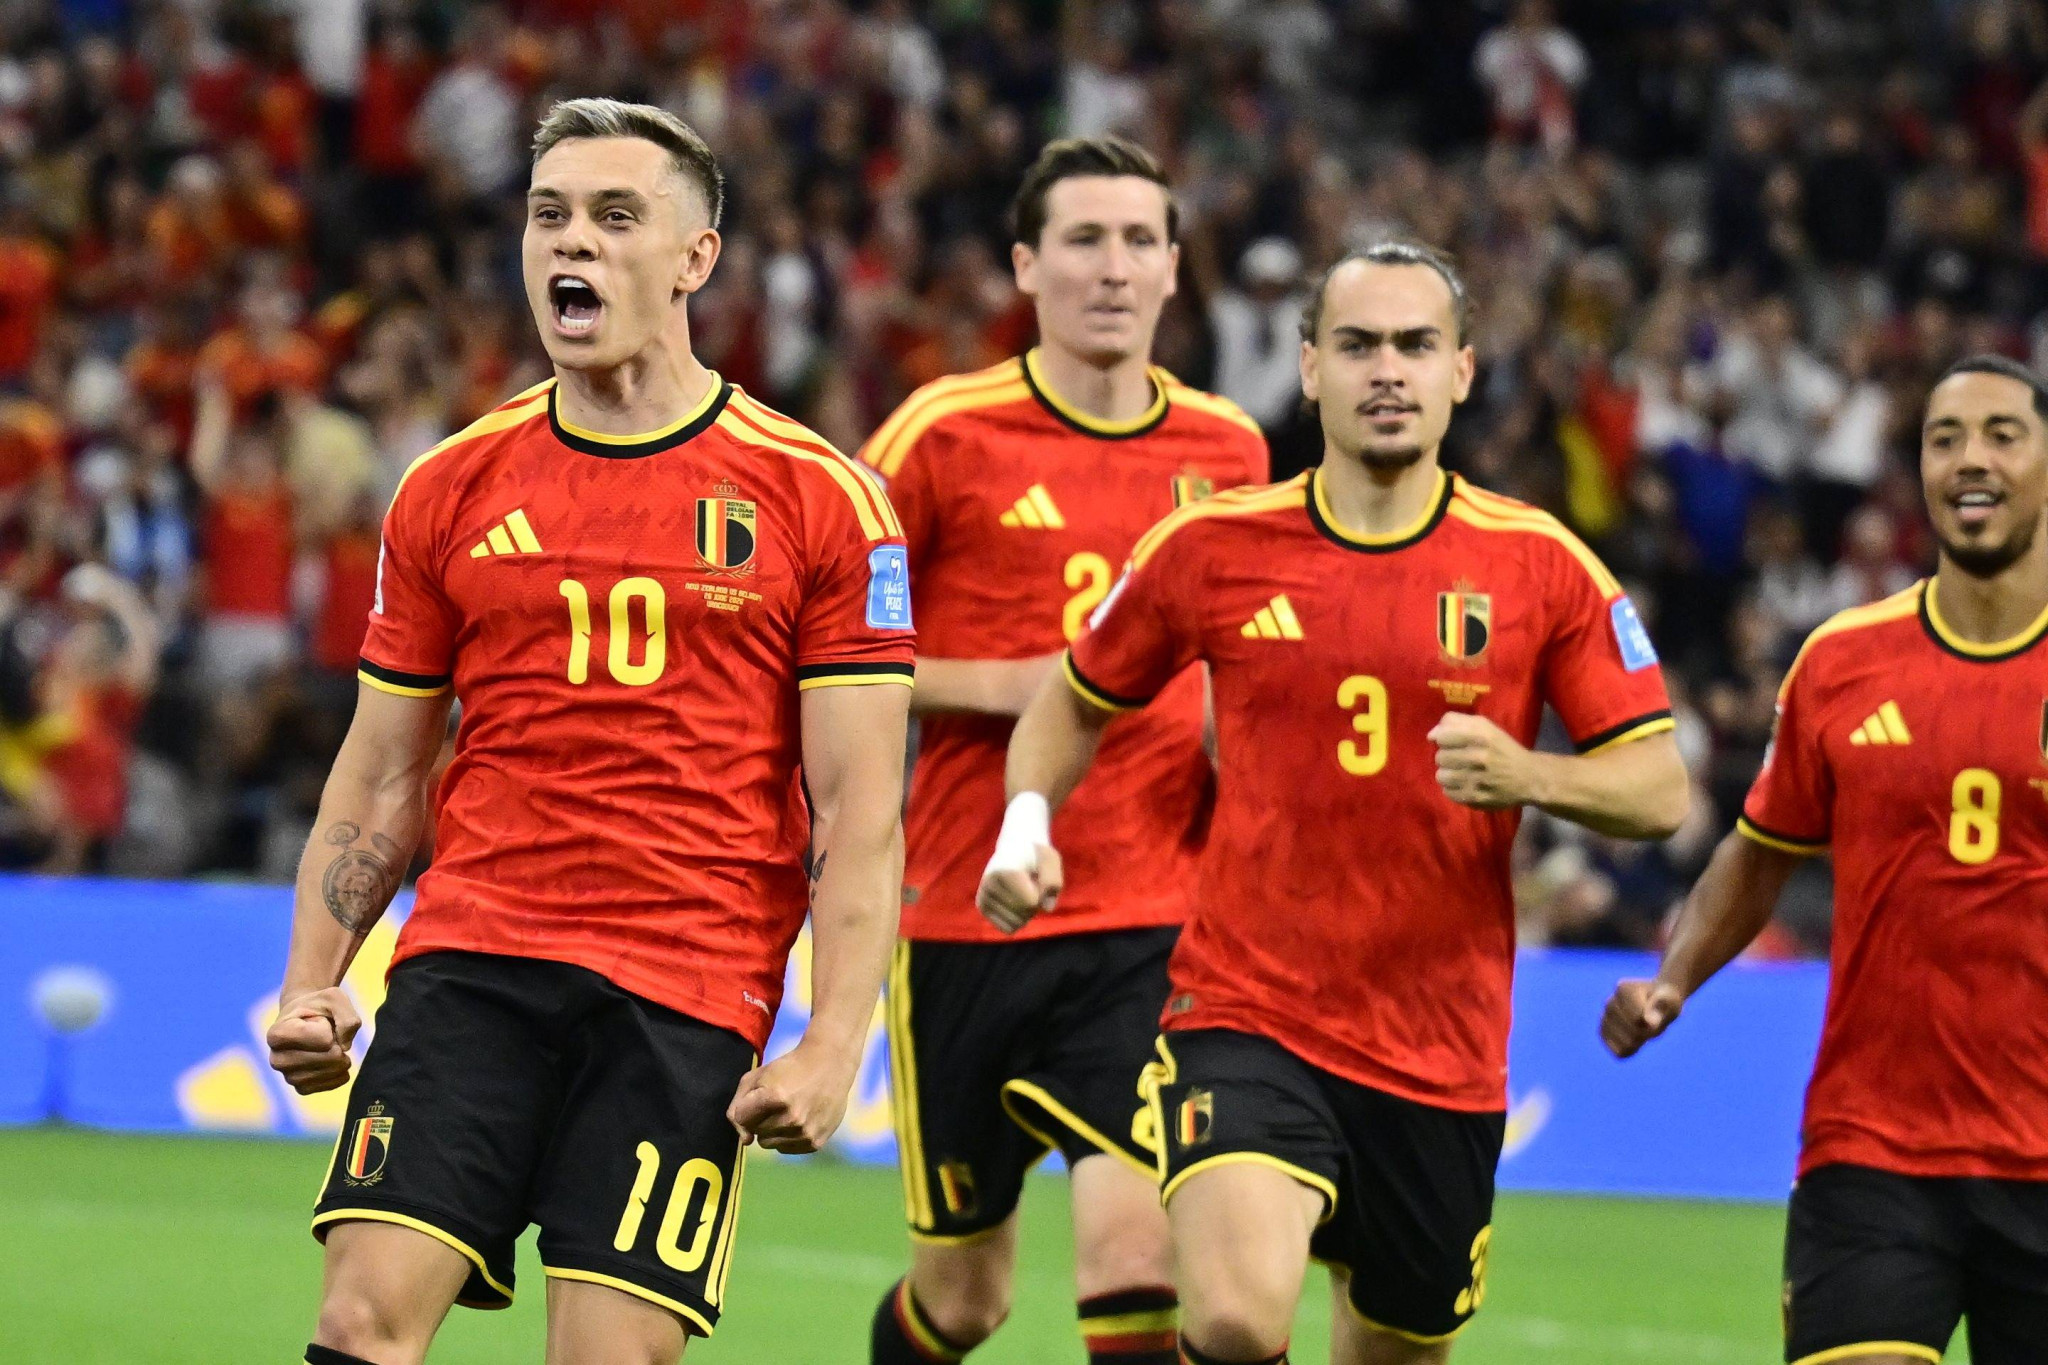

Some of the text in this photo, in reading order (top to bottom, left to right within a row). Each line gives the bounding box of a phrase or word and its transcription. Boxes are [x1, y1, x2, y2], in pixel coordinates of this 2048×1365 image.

[558, 576, 666, 686] 10
[1063, 552, 1112, 641] 2
[1337, 675, 1388, 776] 3
[1949, 768, 2001, 864] 8
[613, 1140, 723, 1273] 10
